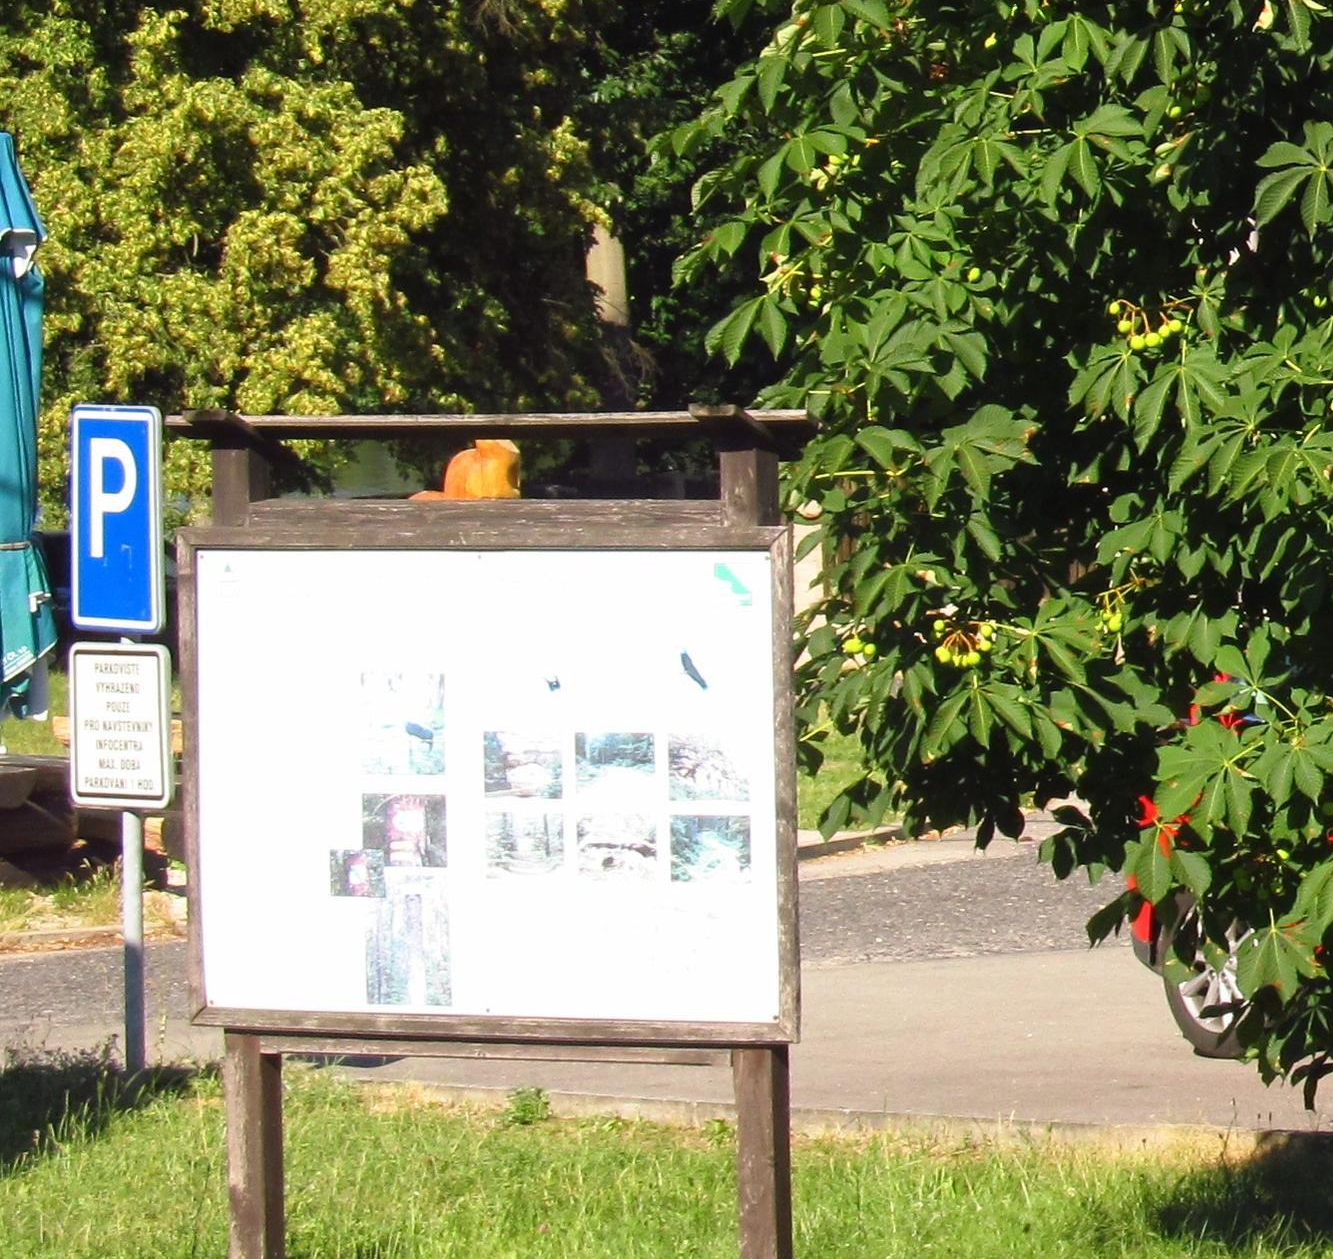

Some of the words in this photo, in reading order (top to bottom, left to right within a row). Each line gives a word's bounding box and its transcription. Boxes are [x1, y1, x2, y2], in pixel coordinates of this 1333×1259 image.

[90, 437, 137, 558] P
[84, 719, 100, 731] PRO
[96, 739, 142, 751] INFOCENTRA
